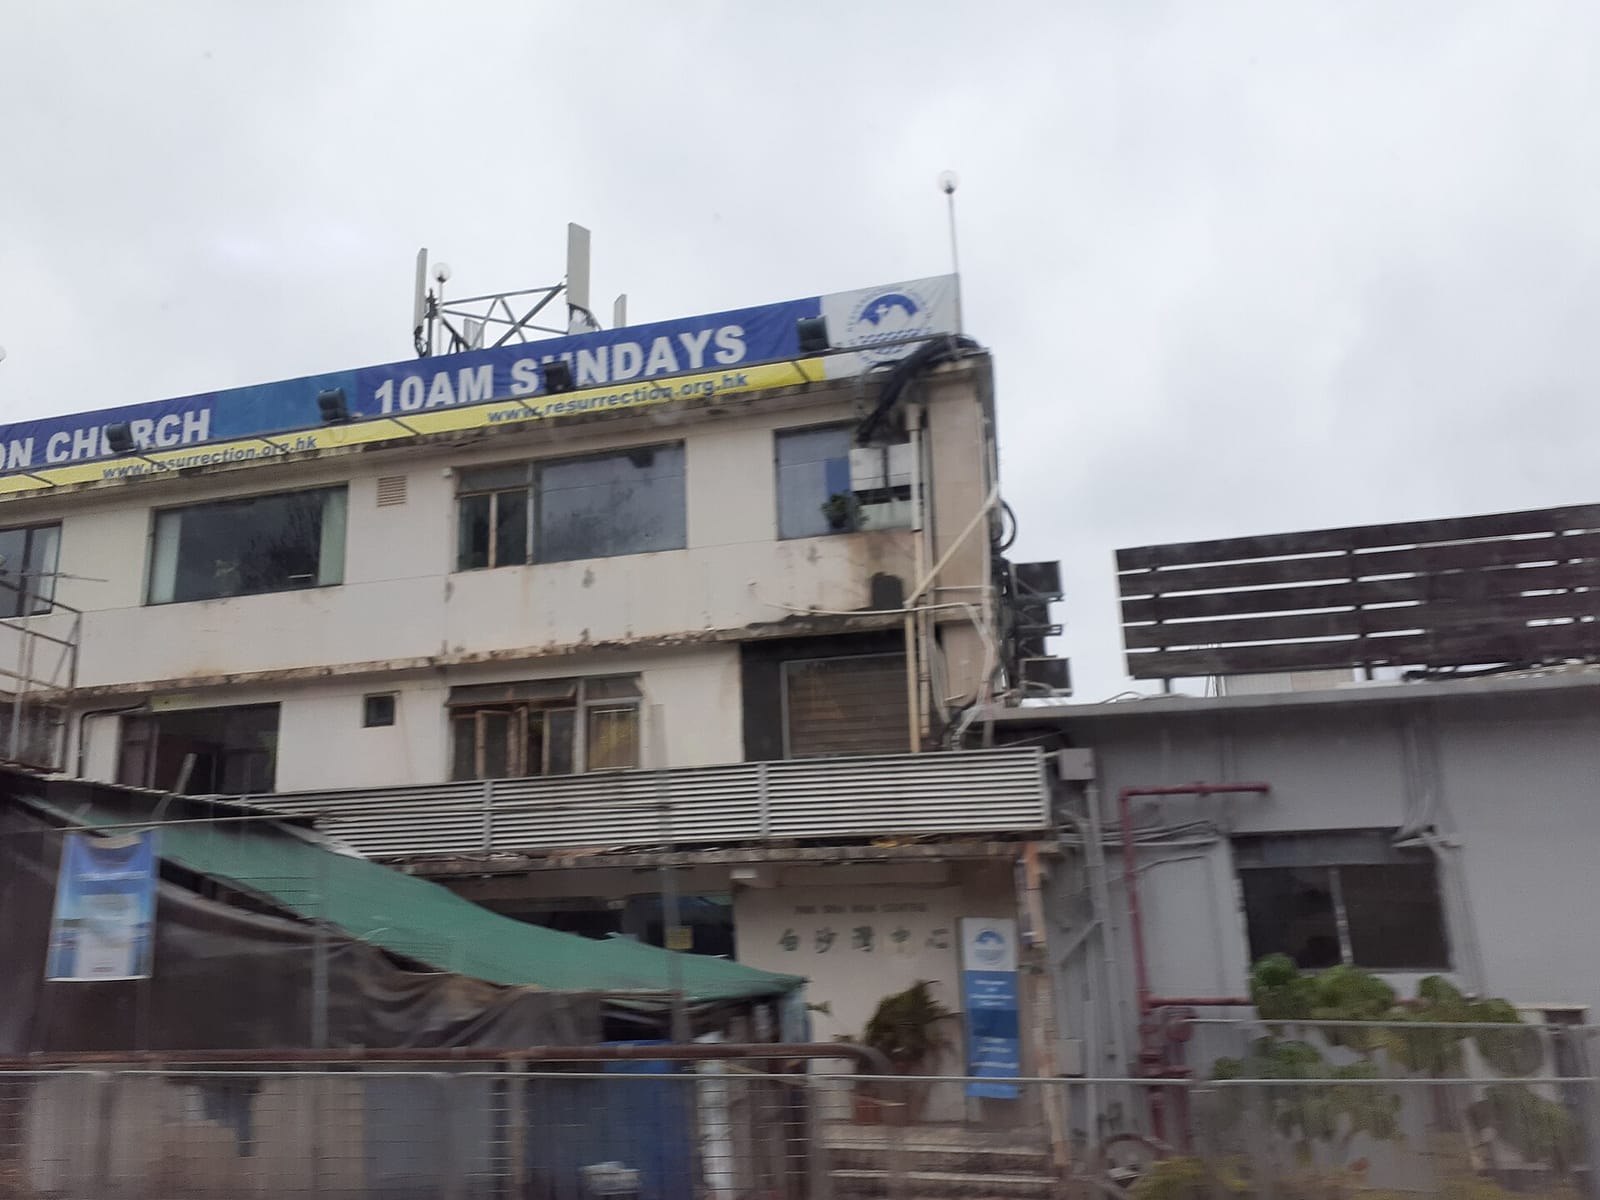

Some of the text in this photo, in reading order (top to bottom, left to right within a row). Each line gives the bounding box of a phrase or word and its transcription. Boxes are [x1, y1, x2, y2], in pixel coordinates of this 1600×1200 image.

[375, 365, 494, 413] 10AM
[487, 371, 749, 423] www.resurrection.org.hk
[0, 437, 34, 470] N
[102, 435, 317, 480] www.resurrection.org.hk
